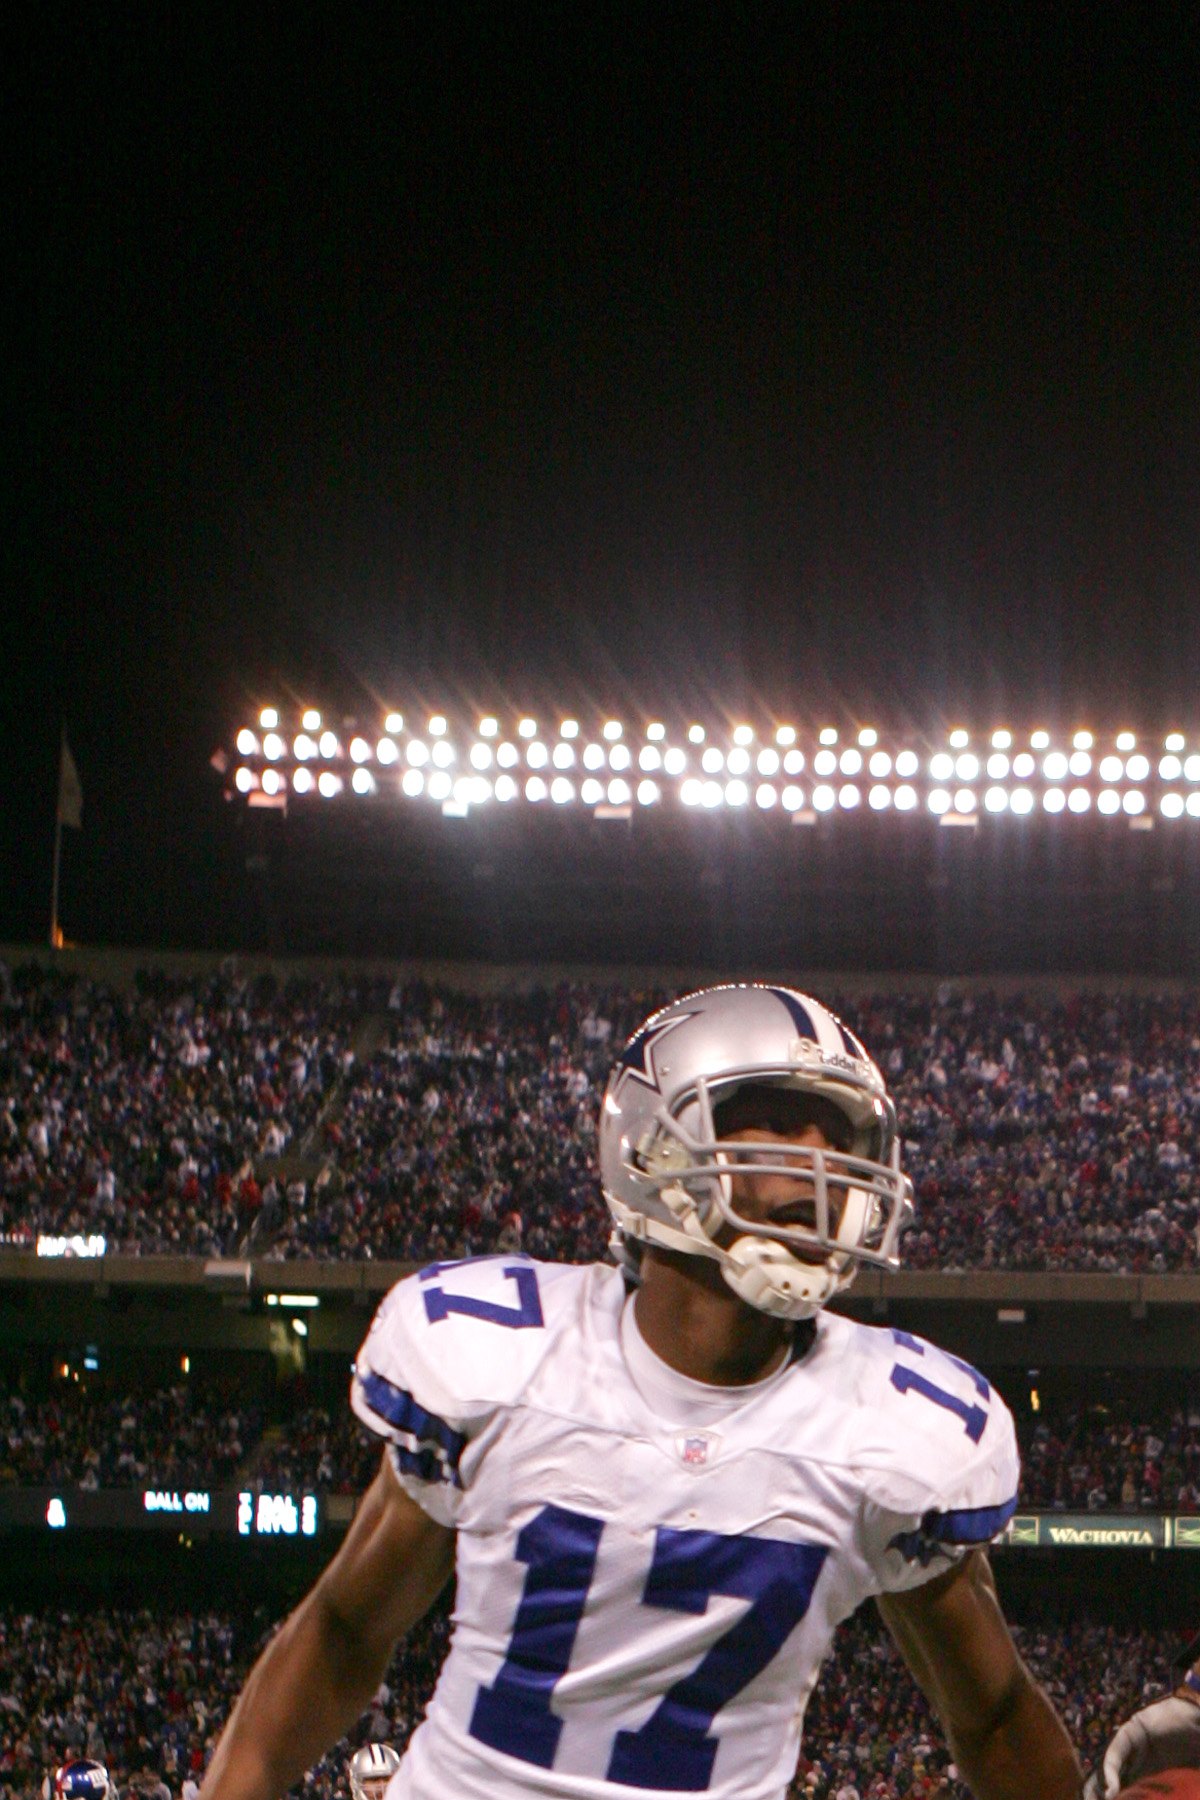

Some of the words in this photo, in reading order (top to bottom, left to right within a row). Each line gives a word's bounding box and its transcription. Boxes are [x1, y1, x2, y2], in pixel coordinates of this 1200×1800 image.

[144, 1491, 182, 1511] BALL
[184, 1492, 210, 1512] ON
[1049, 1527, 1154, 1545] WACHOVIA
[468, 1503, 831, 1791] 17
